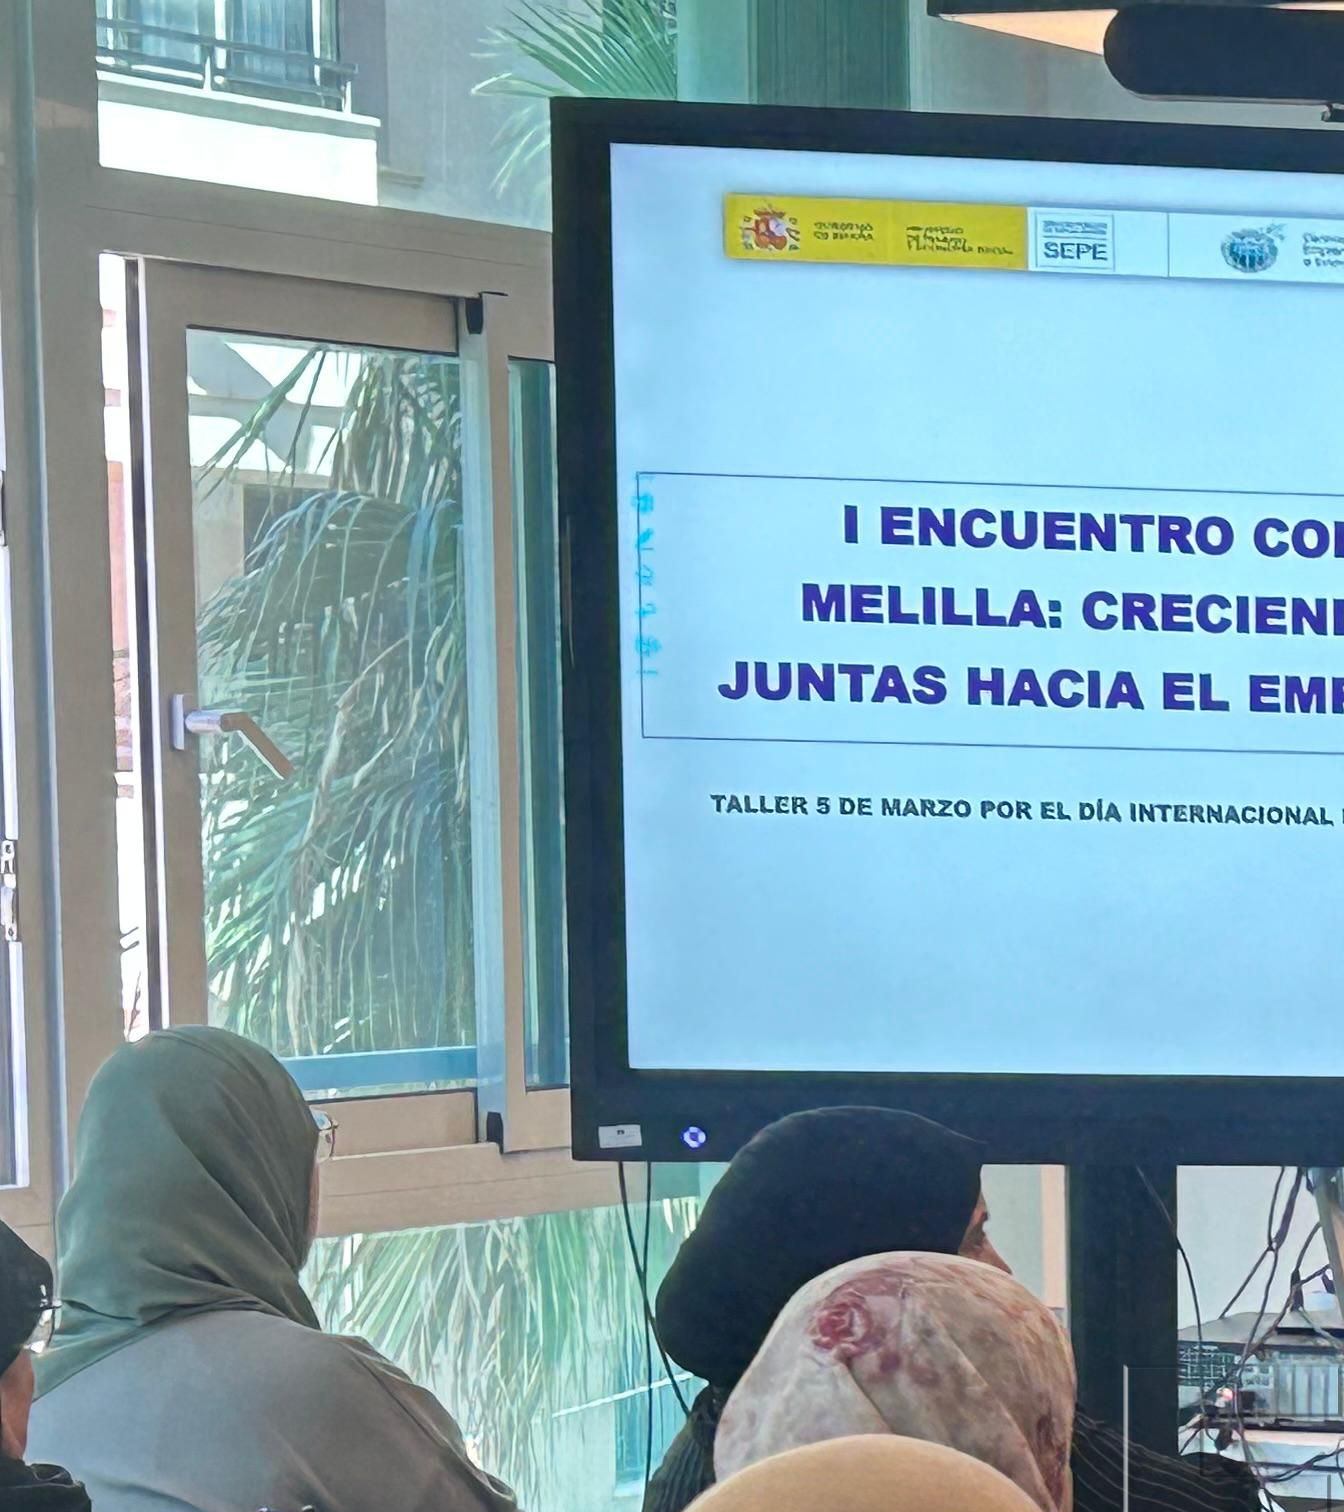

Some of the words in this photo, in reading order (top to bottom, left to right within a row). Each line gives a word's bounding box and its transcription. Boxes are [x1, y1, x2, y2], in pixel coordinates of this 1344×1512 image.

[1043, 241, 1109, 261] SEPE
[844, 505, 858, 543] I
[881, 506, 1235, 556] ENCUENTRO
[802, 583, 1062, 629] MELILLA:
[717, 661, 948, 705] JUNTAS
[967, 667, 1145, 711] HACIA
[1163, 672, 1230, 712] EL
[711, 793, 808, 815] TALLER
[816, 797, 831, 814] 5
[839, 798, 873, 816] DE
[881, 797, 972, 818] MARZO
[981, 800, 1033, 820] POR
[1041, 802, 1071, 820] EL
[1079, 799, 1122, 822] DÍA
[1130, 803, 1334, 826] INTERNACIONAL
